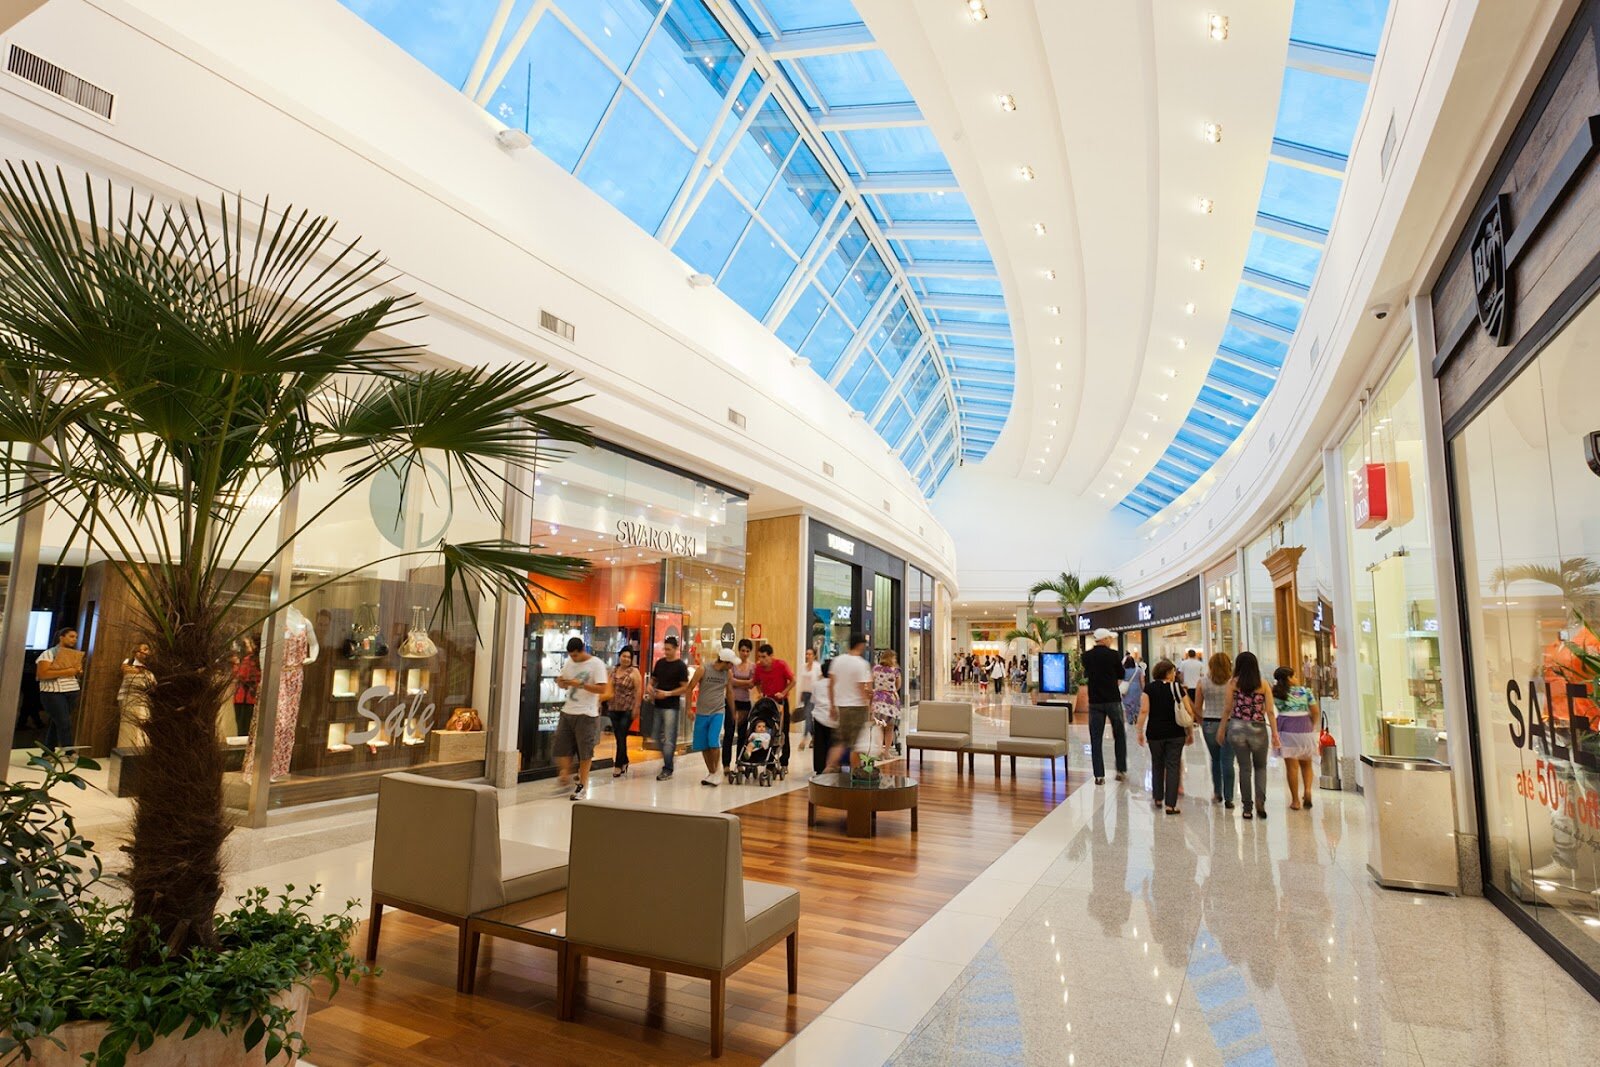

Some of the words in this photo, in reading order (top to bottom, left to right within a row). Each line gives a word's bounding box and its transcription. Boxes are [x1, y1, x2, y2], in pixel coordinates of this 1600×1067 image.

[615, 519, 697, 557] SWAROVSKI
[346, 685, 436, 745] Sale
[1506, 679, 1600, 771] SALE
[1516, 769, 1535, 801] até
[1536, 758, 1575, 819] 50%
